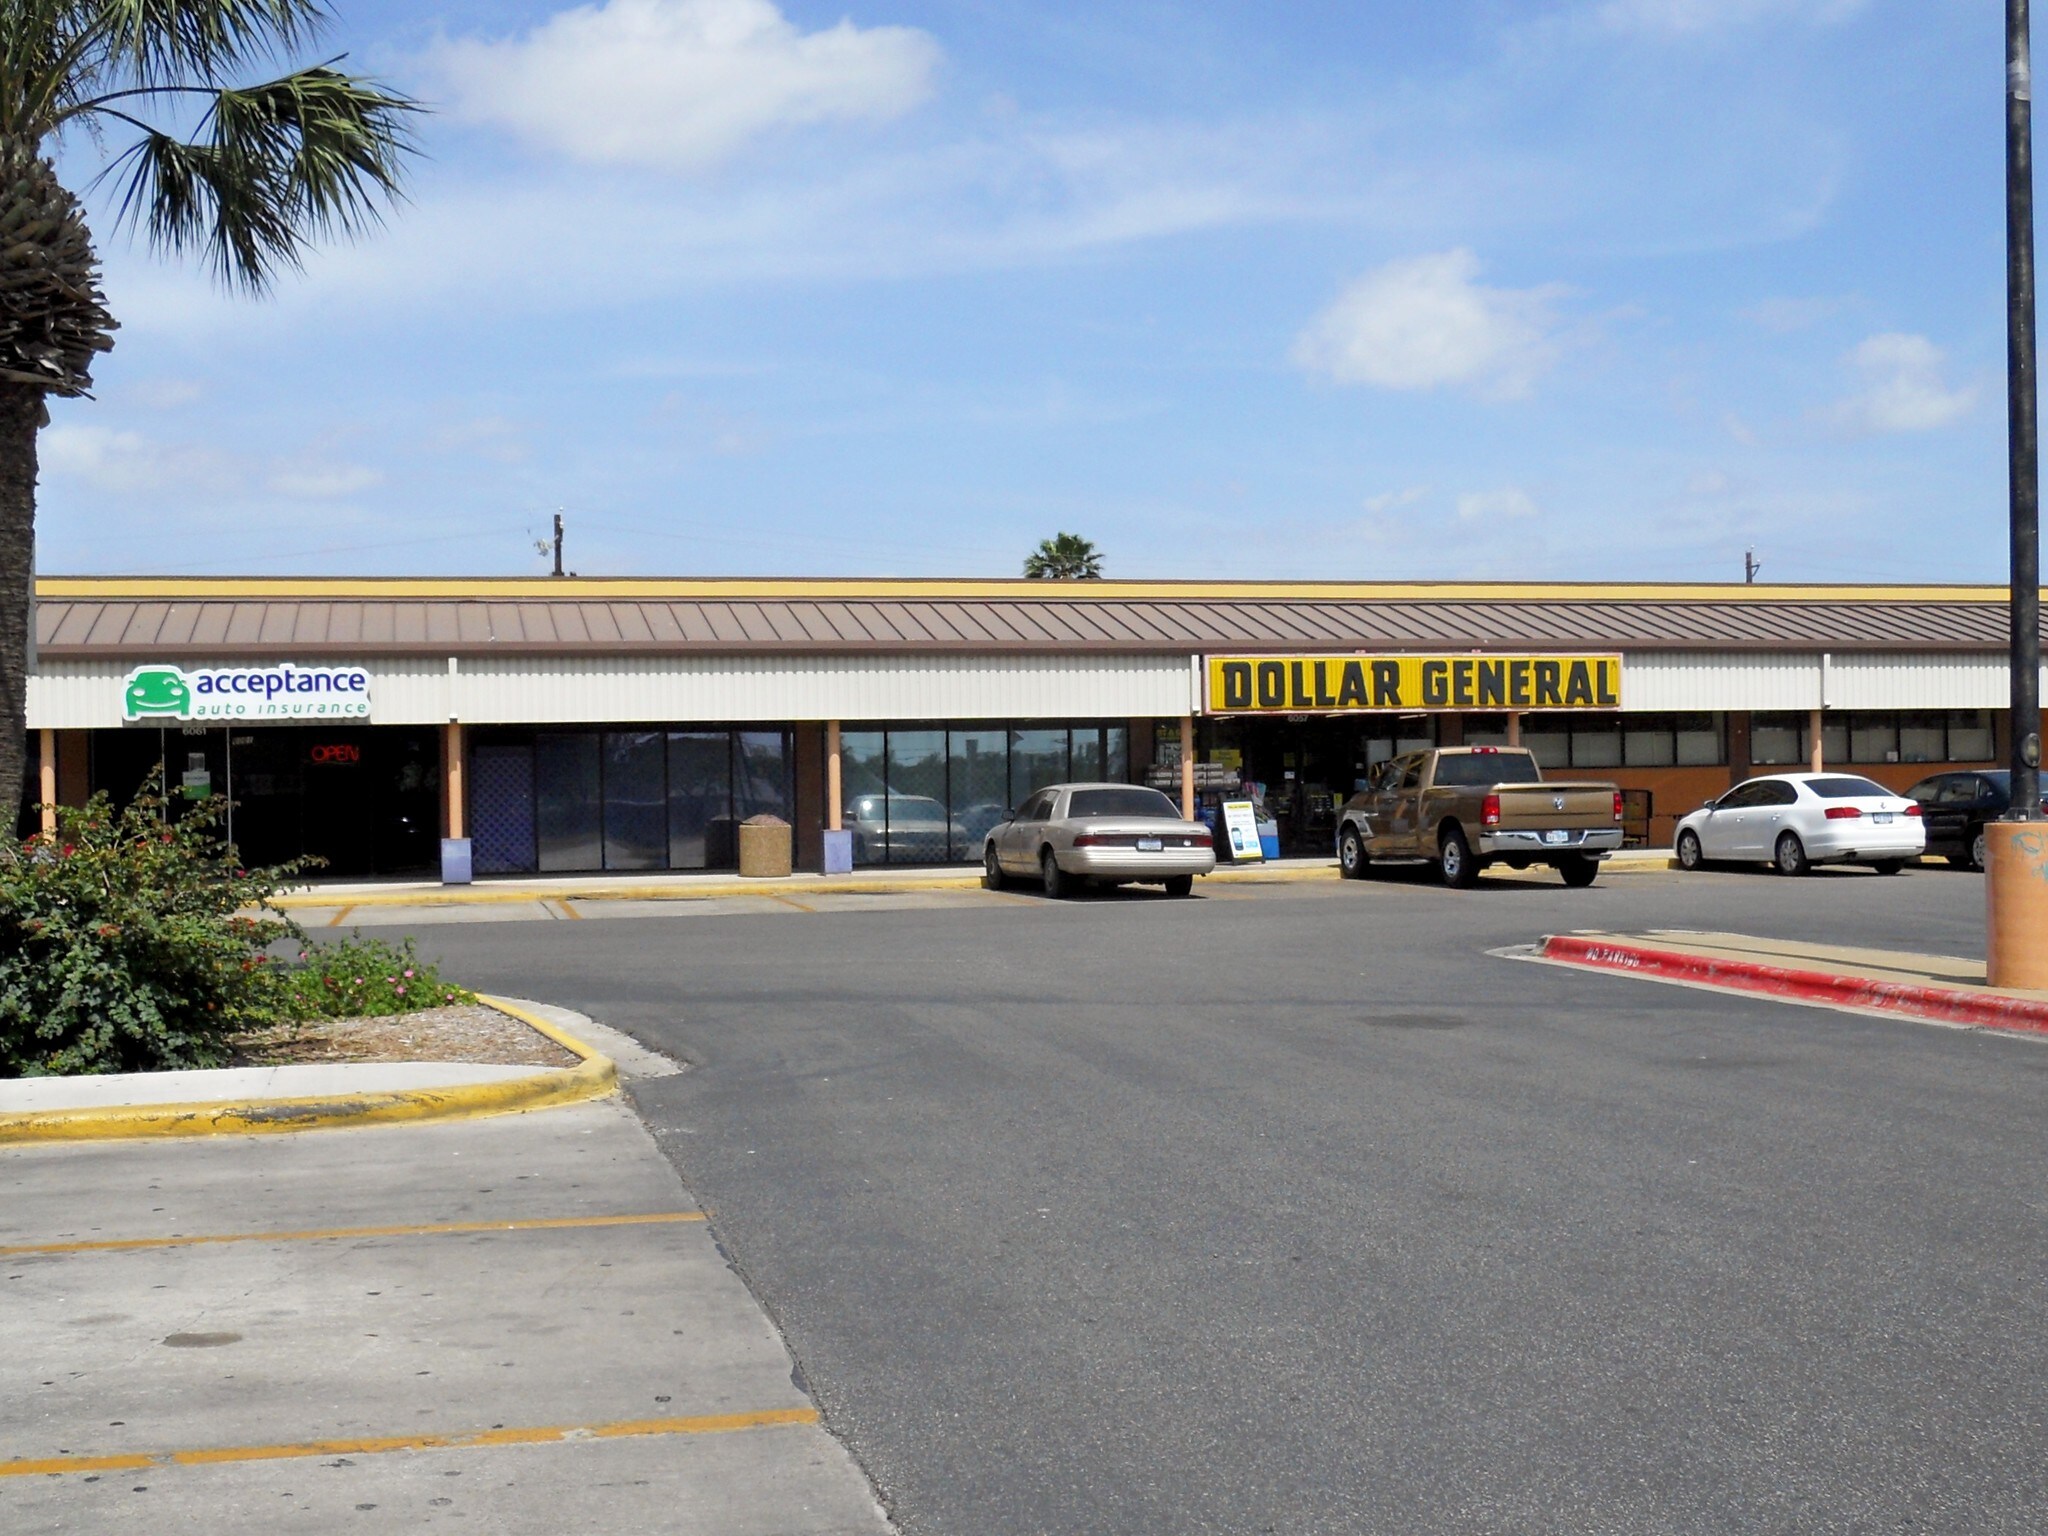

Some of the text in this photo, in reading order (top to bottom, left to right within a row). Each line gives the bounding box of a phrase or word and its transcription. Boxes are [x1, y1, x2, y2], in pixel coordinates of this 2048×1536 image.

[197, 669, 366, 700] acceptance
[1222, 660, 1616, 707] DOLLAR GENERAL
[197, 702, 367, 715] auto insurance
[311, 744, 360, 761] OPEN
[1585, 947, 1600, 961] NO
